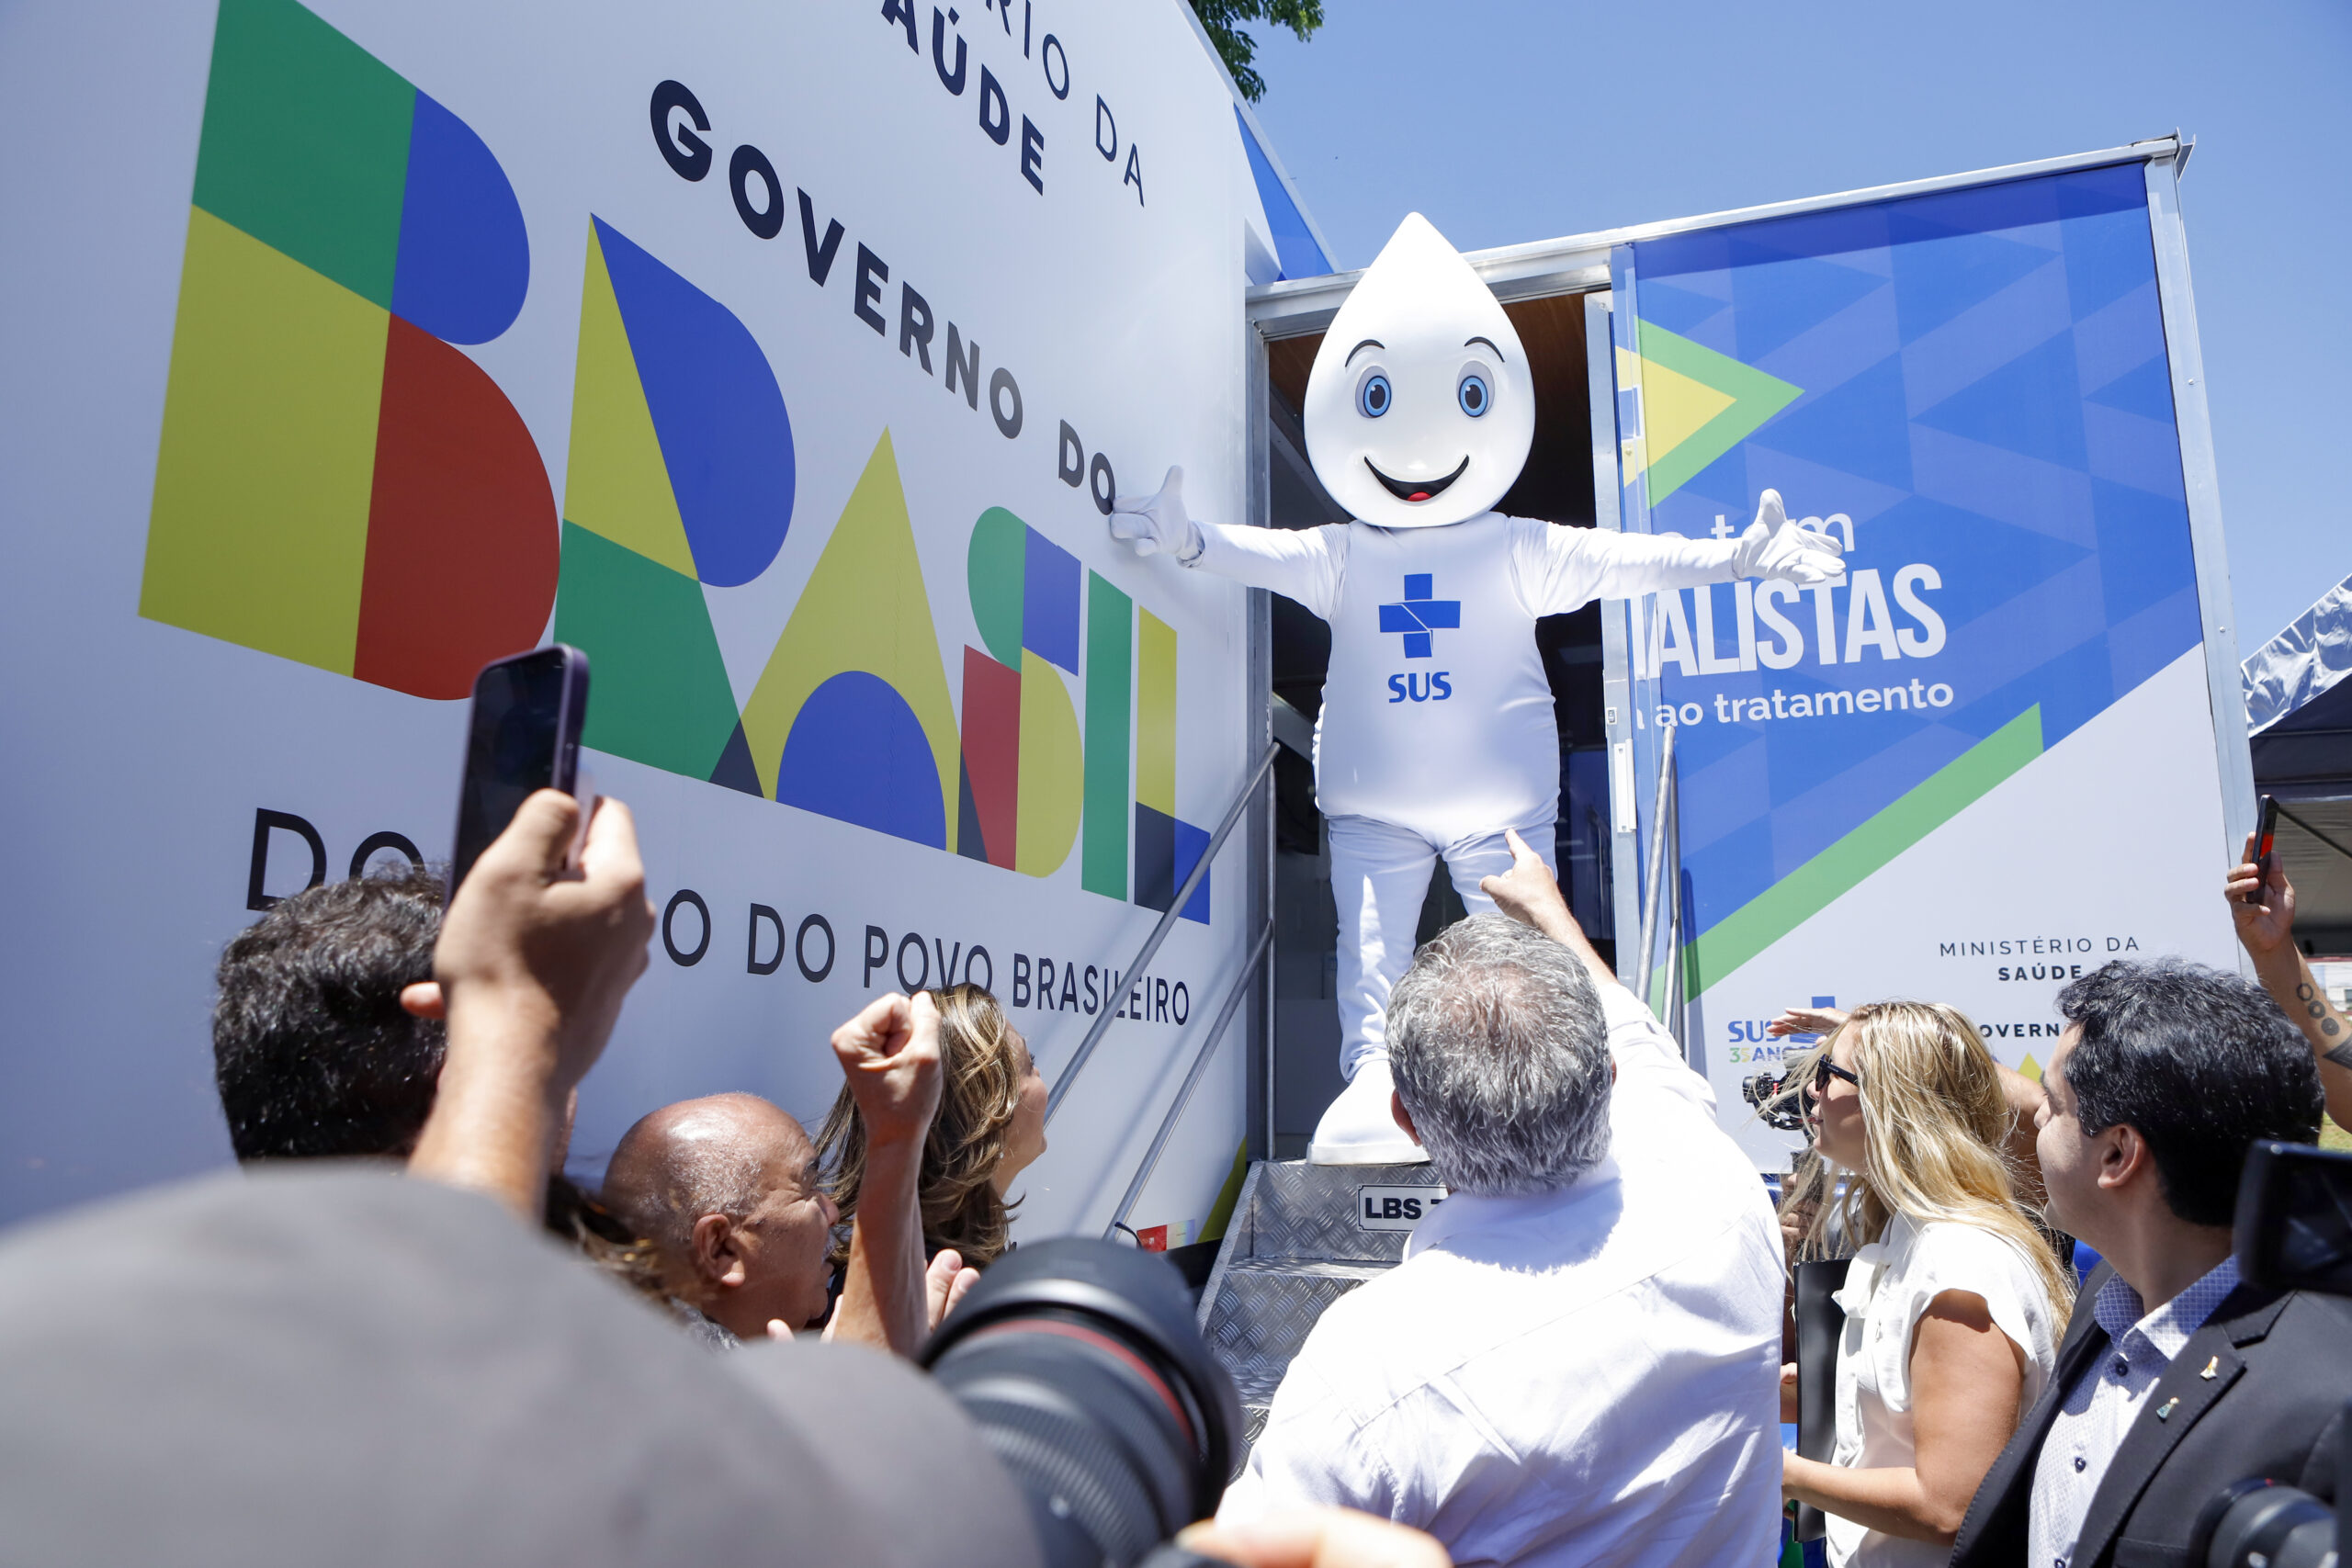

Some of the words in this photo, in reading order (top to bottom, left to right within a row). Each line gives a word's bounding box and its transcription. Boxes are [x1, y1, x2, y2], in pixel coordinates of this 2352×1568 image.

[1096, 93, 1144, 207] DA
[650, 79, 1023, 439] GOVERNO
[1058, 418, 1116, 515] DO
[138, 0, 1211, 926] BRASIL
[1710, 513, 1856, 553] tm
[1387, 671, 1452, 703] SUS
[1655, 701, 1703, 728] ao
[1714, 678, 1954, 724] tratamento
[746, 902, 836, 983] DO
[863, 924, 993, 997] POVO
[1939, 936, 2092, 957] MINISTÉRIO
[2107, 936, 2140, 953] DA
[1997, 962, 2082, 982] SAÚDE
[1979, 1022, 2061, 1038] OVERN
[1364, 1197, 1422, 1220] LBS
